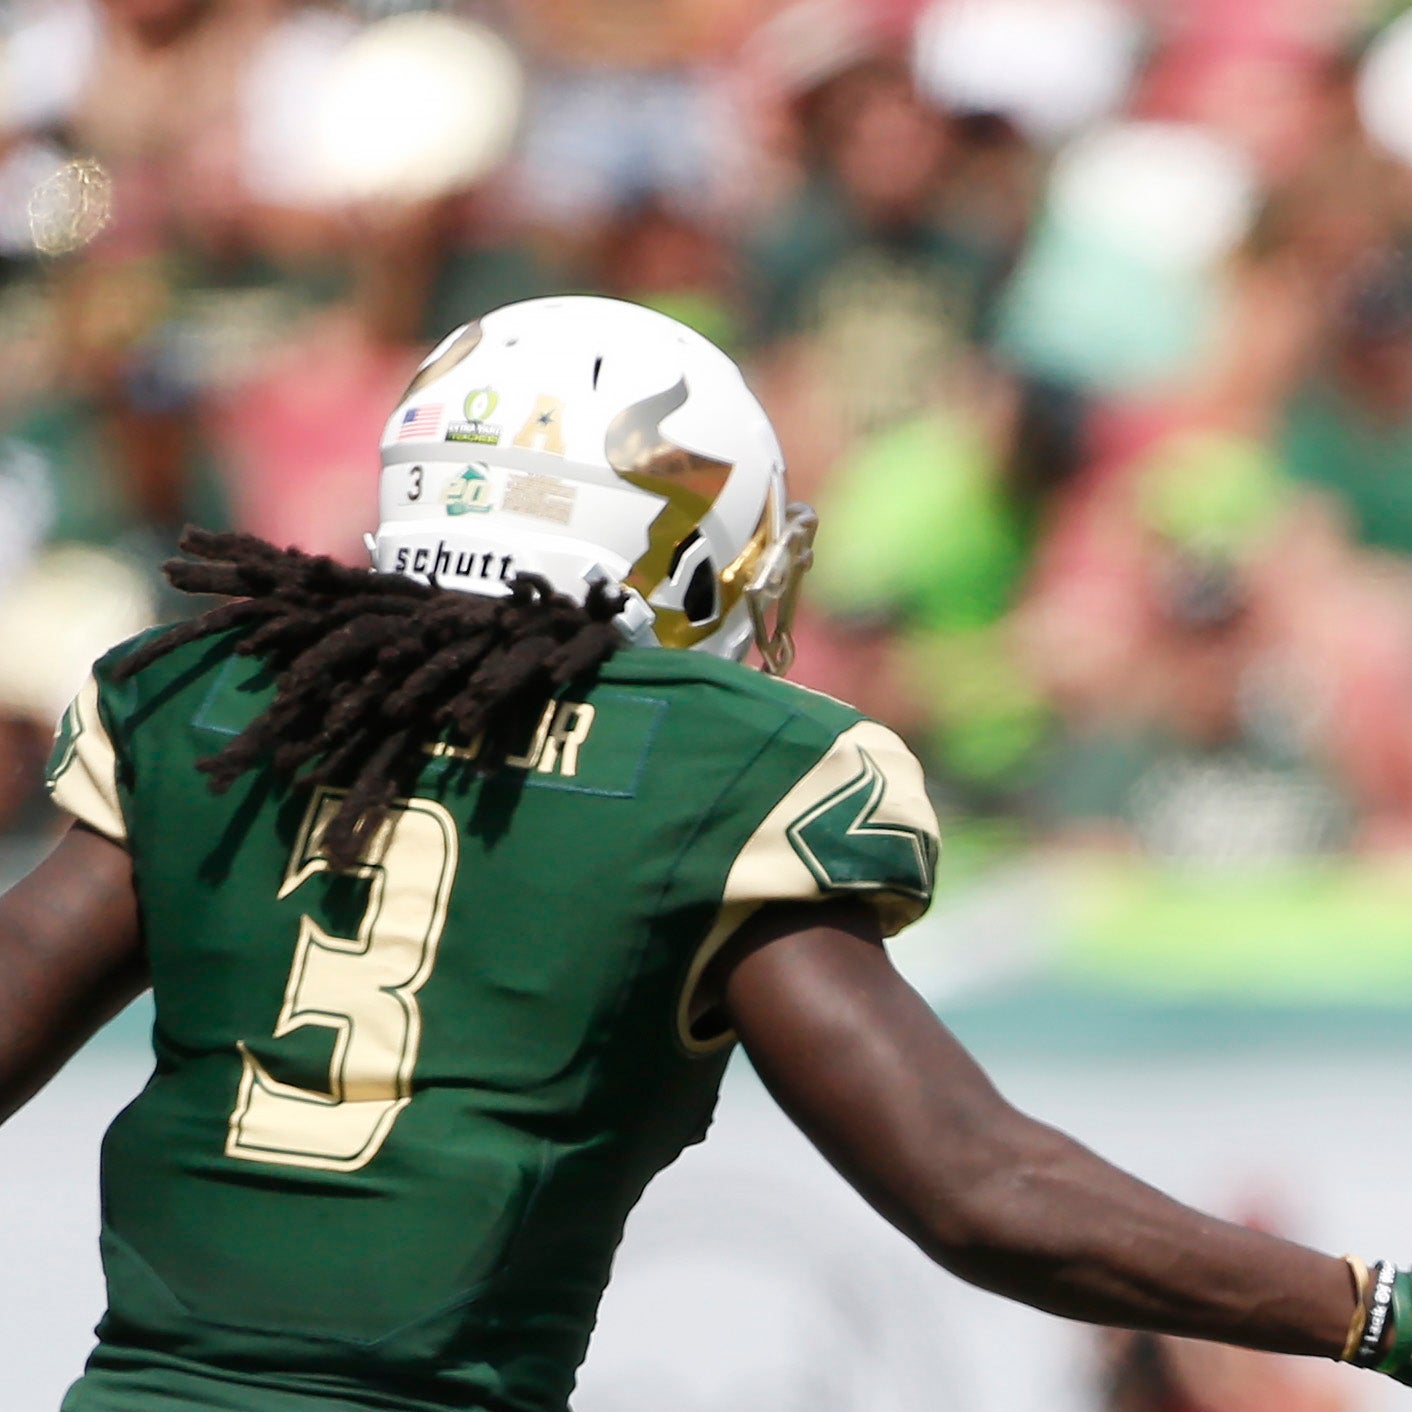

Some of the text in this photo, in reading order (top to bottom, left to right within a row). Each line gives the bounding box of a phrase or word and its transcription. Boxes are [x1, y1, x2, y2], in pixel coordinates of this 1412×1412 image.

[407, 465, 424, 501] 3
[395, 540, 512, 580] schutt
[224, 786, 459, 1173] 3
